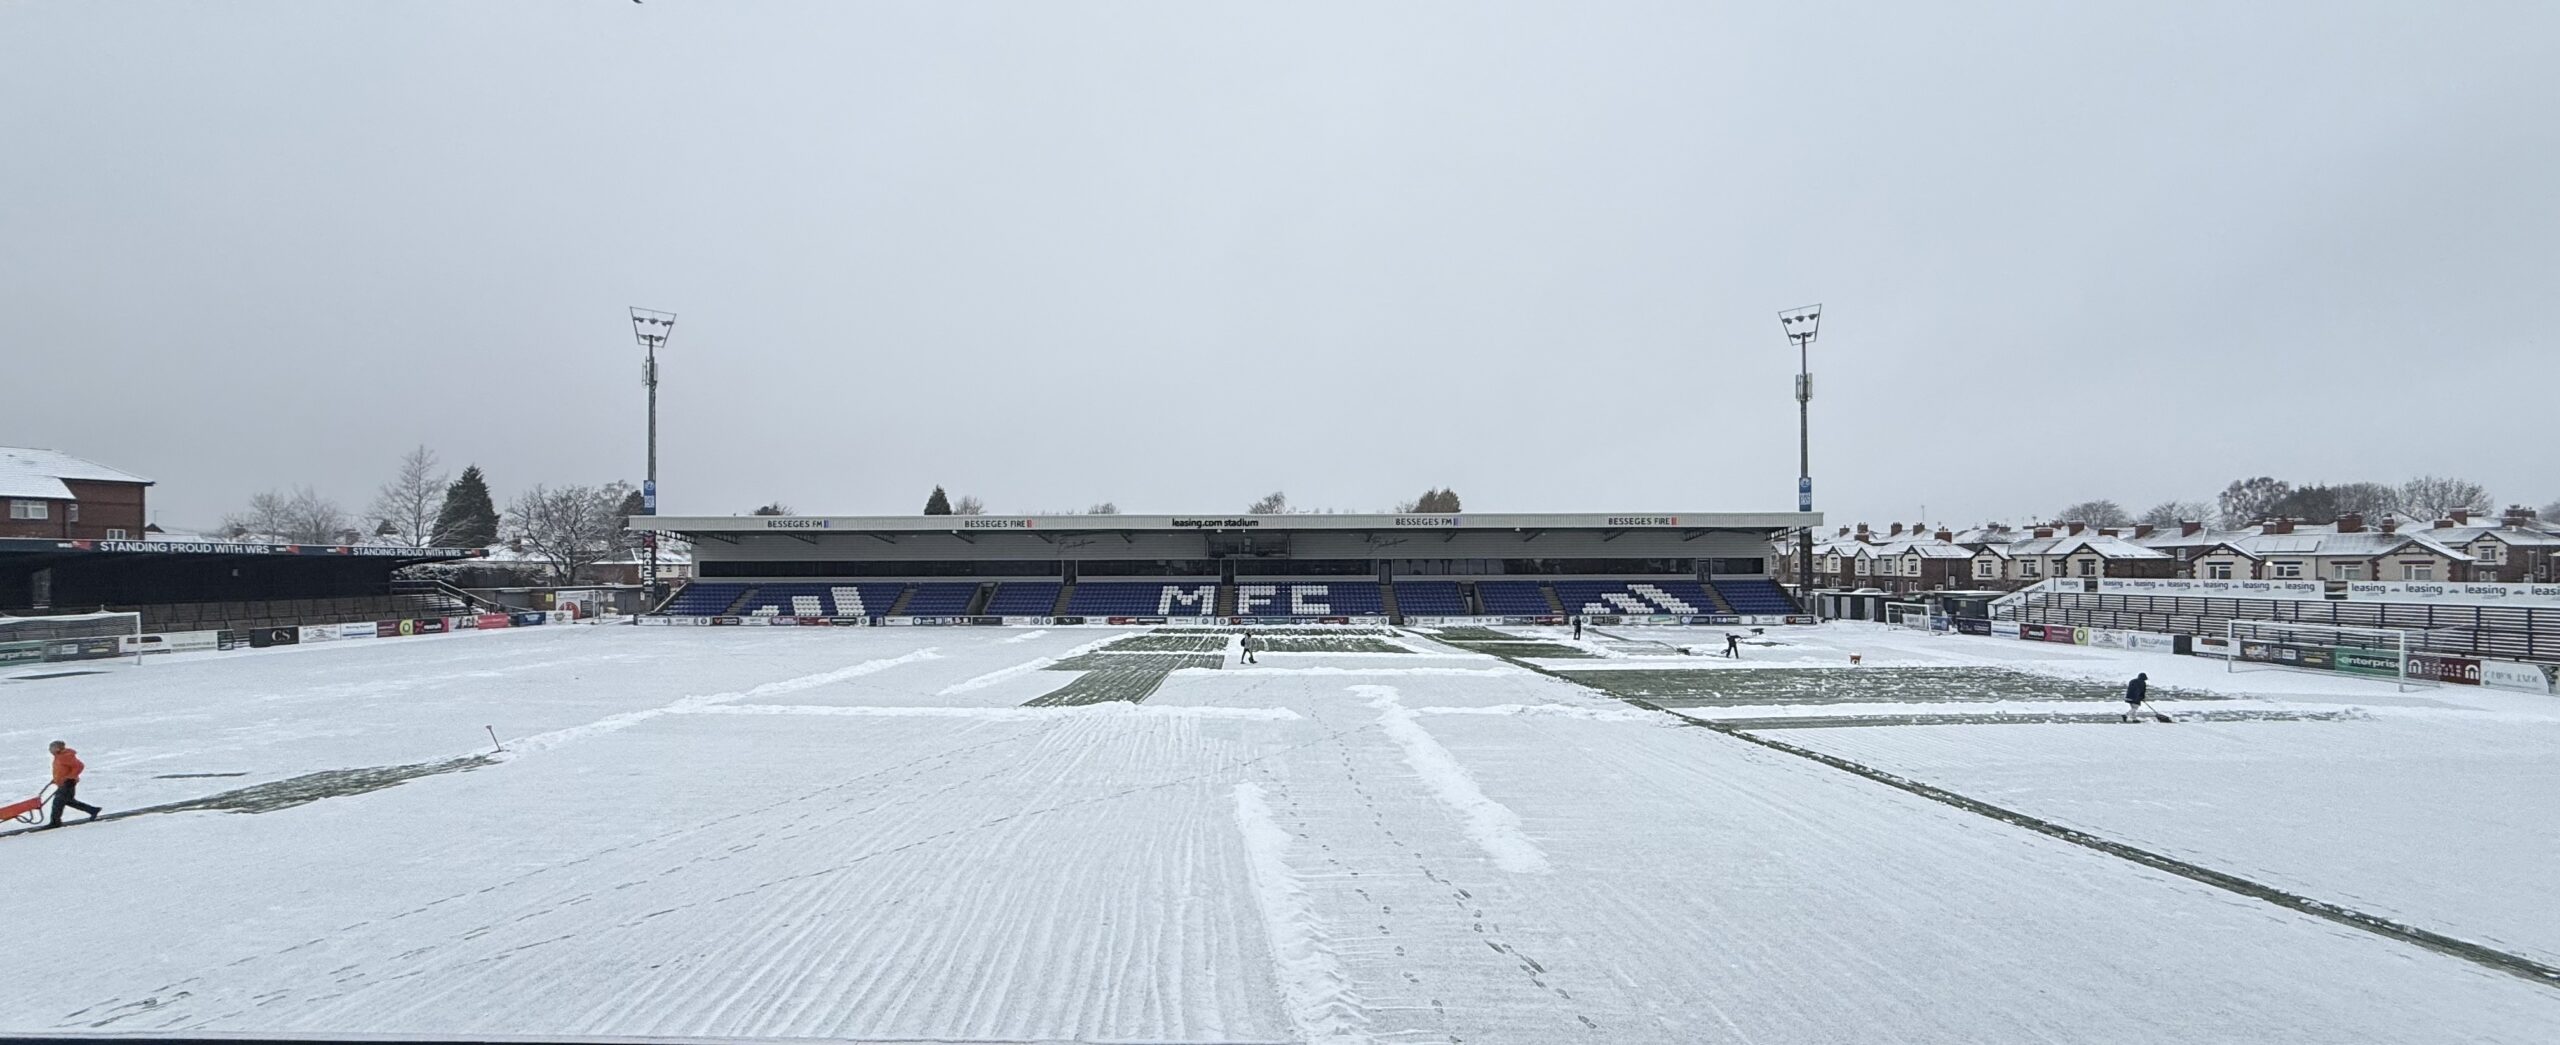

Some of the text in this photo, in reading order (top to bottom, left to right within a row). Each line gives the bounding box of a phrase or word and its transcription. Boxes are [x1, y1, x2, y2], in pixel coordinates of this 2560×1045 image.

[767, 520, 823, 528] BESSEGES FM
[965, 520, 1026, 528] BESSEGES FIRE
[1172, 517, 1259, 528] leasing.com stadium
[1395, 517, 1453, 526] BESSEGES FM
[1608, 517, 1670, 526] BESSEGES FIRE
[100, 541, 168, 552] STANDING
[170, 543, 212, 553] PROUD
[214, 544, 243, 554] WITH
[245, 545, 270, 554] WRS
[352, 547, 397, 556] STANDING
[397, 548, 424, 557] PROUD
[425, 549, 444, 557] WITH
[643, 547, 655, 586] recruit
[2167, 580, 2191, 590] leasing
[2203, 580, 2229, 591] leasing
[2242, 581, 2270, 591] leasing
[2285, 581, 2316, 593] leasing
[2351, 583, 2386, 594] leasing
[2405, 584, 2443, 595] leasing
[2465, 584, 2507, 597] leasing
[271, 629, 291, 642] CS
